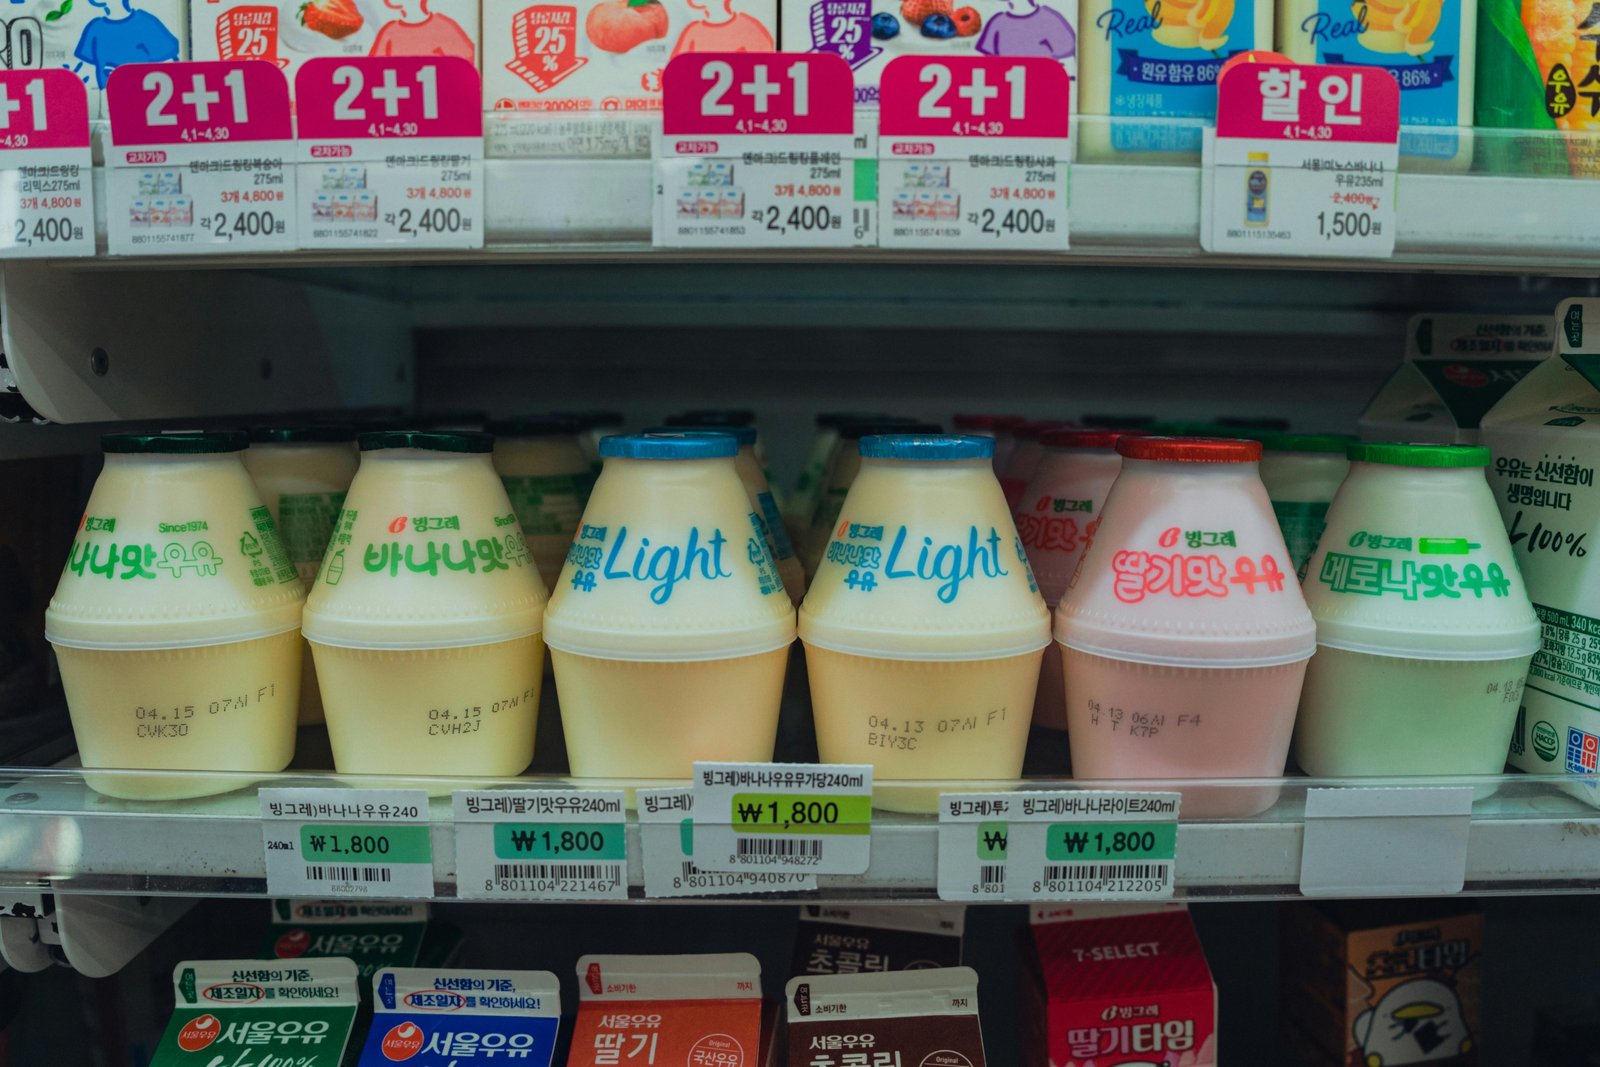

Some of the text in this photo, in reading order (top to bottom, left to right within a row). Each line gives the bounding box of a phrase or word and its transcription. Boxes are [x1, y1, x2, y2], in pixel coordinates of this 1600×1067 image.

[830, 16, 862, 44] 25
[1096, 1, 1163, 41] Real
[1301, 5, 1369, 46] Real
[237, 28, 268, 56] 25
[533, 26, 566, 55] 25
[1142, 62, 1196, 83] 원유함유
[1402, 70, 1430, 87] 86%
[143, 69, 250, 126] 2+1
[332, 65, 438, 121] 2+1
[700, 61, 808, 116] 2+1
[919, 63, 1026, 118] 2+1
[1548, 69, 1571, 115] 우유
[254, 174, 283, 185] 275ml
[441, 170, 471, 181] 275ml
[809, 167, 841, 179] 275ml
[1025, 170, 1056, 183] 275ml
[200, 218, 211, 230] 각
[385, 213, 396, 226] 각
[752, 210, 764, 223] 각
[968, 213, 979, 226] 각
[1495, 457, 1594, 487] 우유는 신선함이
[1053, 498, 1093, 513] 빙그레
[1507, 482, 1572, 511] 생명입니다
[85, 516, 116, 533] 빙그레
[158, 520, 209, 534] Since1974
[412, 516, 460, 533] 빙그레
[849, 524, 883, 541] 빙그레
[1184, 530, 1236, 548] 빙그레
[1368, 535, 1412, 552] 빙그레
[65, 540, 224, 580] 나나맛우유
[604, 527, 732, 605] Light
[885, 525, 1009, 604] Light
[844, 570, 878, 592] 우유
[1571, 615, 1587, 631] 340
[136, 705, 195, 720] 04.15
[429, 706, 482, 721] 04.15
[1088, 700, 1201, 727] 04.13 F4
[868, 715, 925, 733] 04.13
[1536, 731, 1556, 746] HACCP
[703, 770, 864, 788] 빙그레)바나나우유무가당240ml
[269, 802, 418, 819] 빙그레)바나나우유240
[466, 796, 621, 814] 빙그레)딸기맛우유240ml
[645, 793, 693, 812] 빙그레)
[1022, 797, 1175, 815] 빙그레)바나나라이트240ml
[737, 801, 839, 829] ₩1,800
[267, 840, 294, 851] 240ml
[309, 834, 390, 855] ₩1,800
[510, 830, 605, 855] ₩1,800
[1063, 831, 1155, 856] ₩1,800
[739, 854, 777, 865] 801104
[500, 879, 555, 892] 801104
[688, 874, 744, 888] 801104
[1047, 881, 1103, 893] 801104
[1072, 942, 1160, 963] 7-SELECT
[231, 969, 314, 984] 신선함의 기준,
[433, 977, 517, 993] 신선함의 기준,
[278, 985, 340, 999] 확인하세요!
[606, 982, 753, 994] 소비기한 까지
[479, 995, 541, 1010] 확인하세요!
[815, 998, 967, 1014] 소비기한 까지
[598, 1013, 662, 1029] 서울우유
[1118, 1004, 1160, 1020] 빙그레
[216, 1020, 330, 1045] 서울우유
[808, 1032, 876, 1051] 서울우유
[1066, 1018, 1195, 1059] 딸기타임
[421, 1032, 535, 1058] 서울우유
[594, 1032, 658, 1065] 딸기
